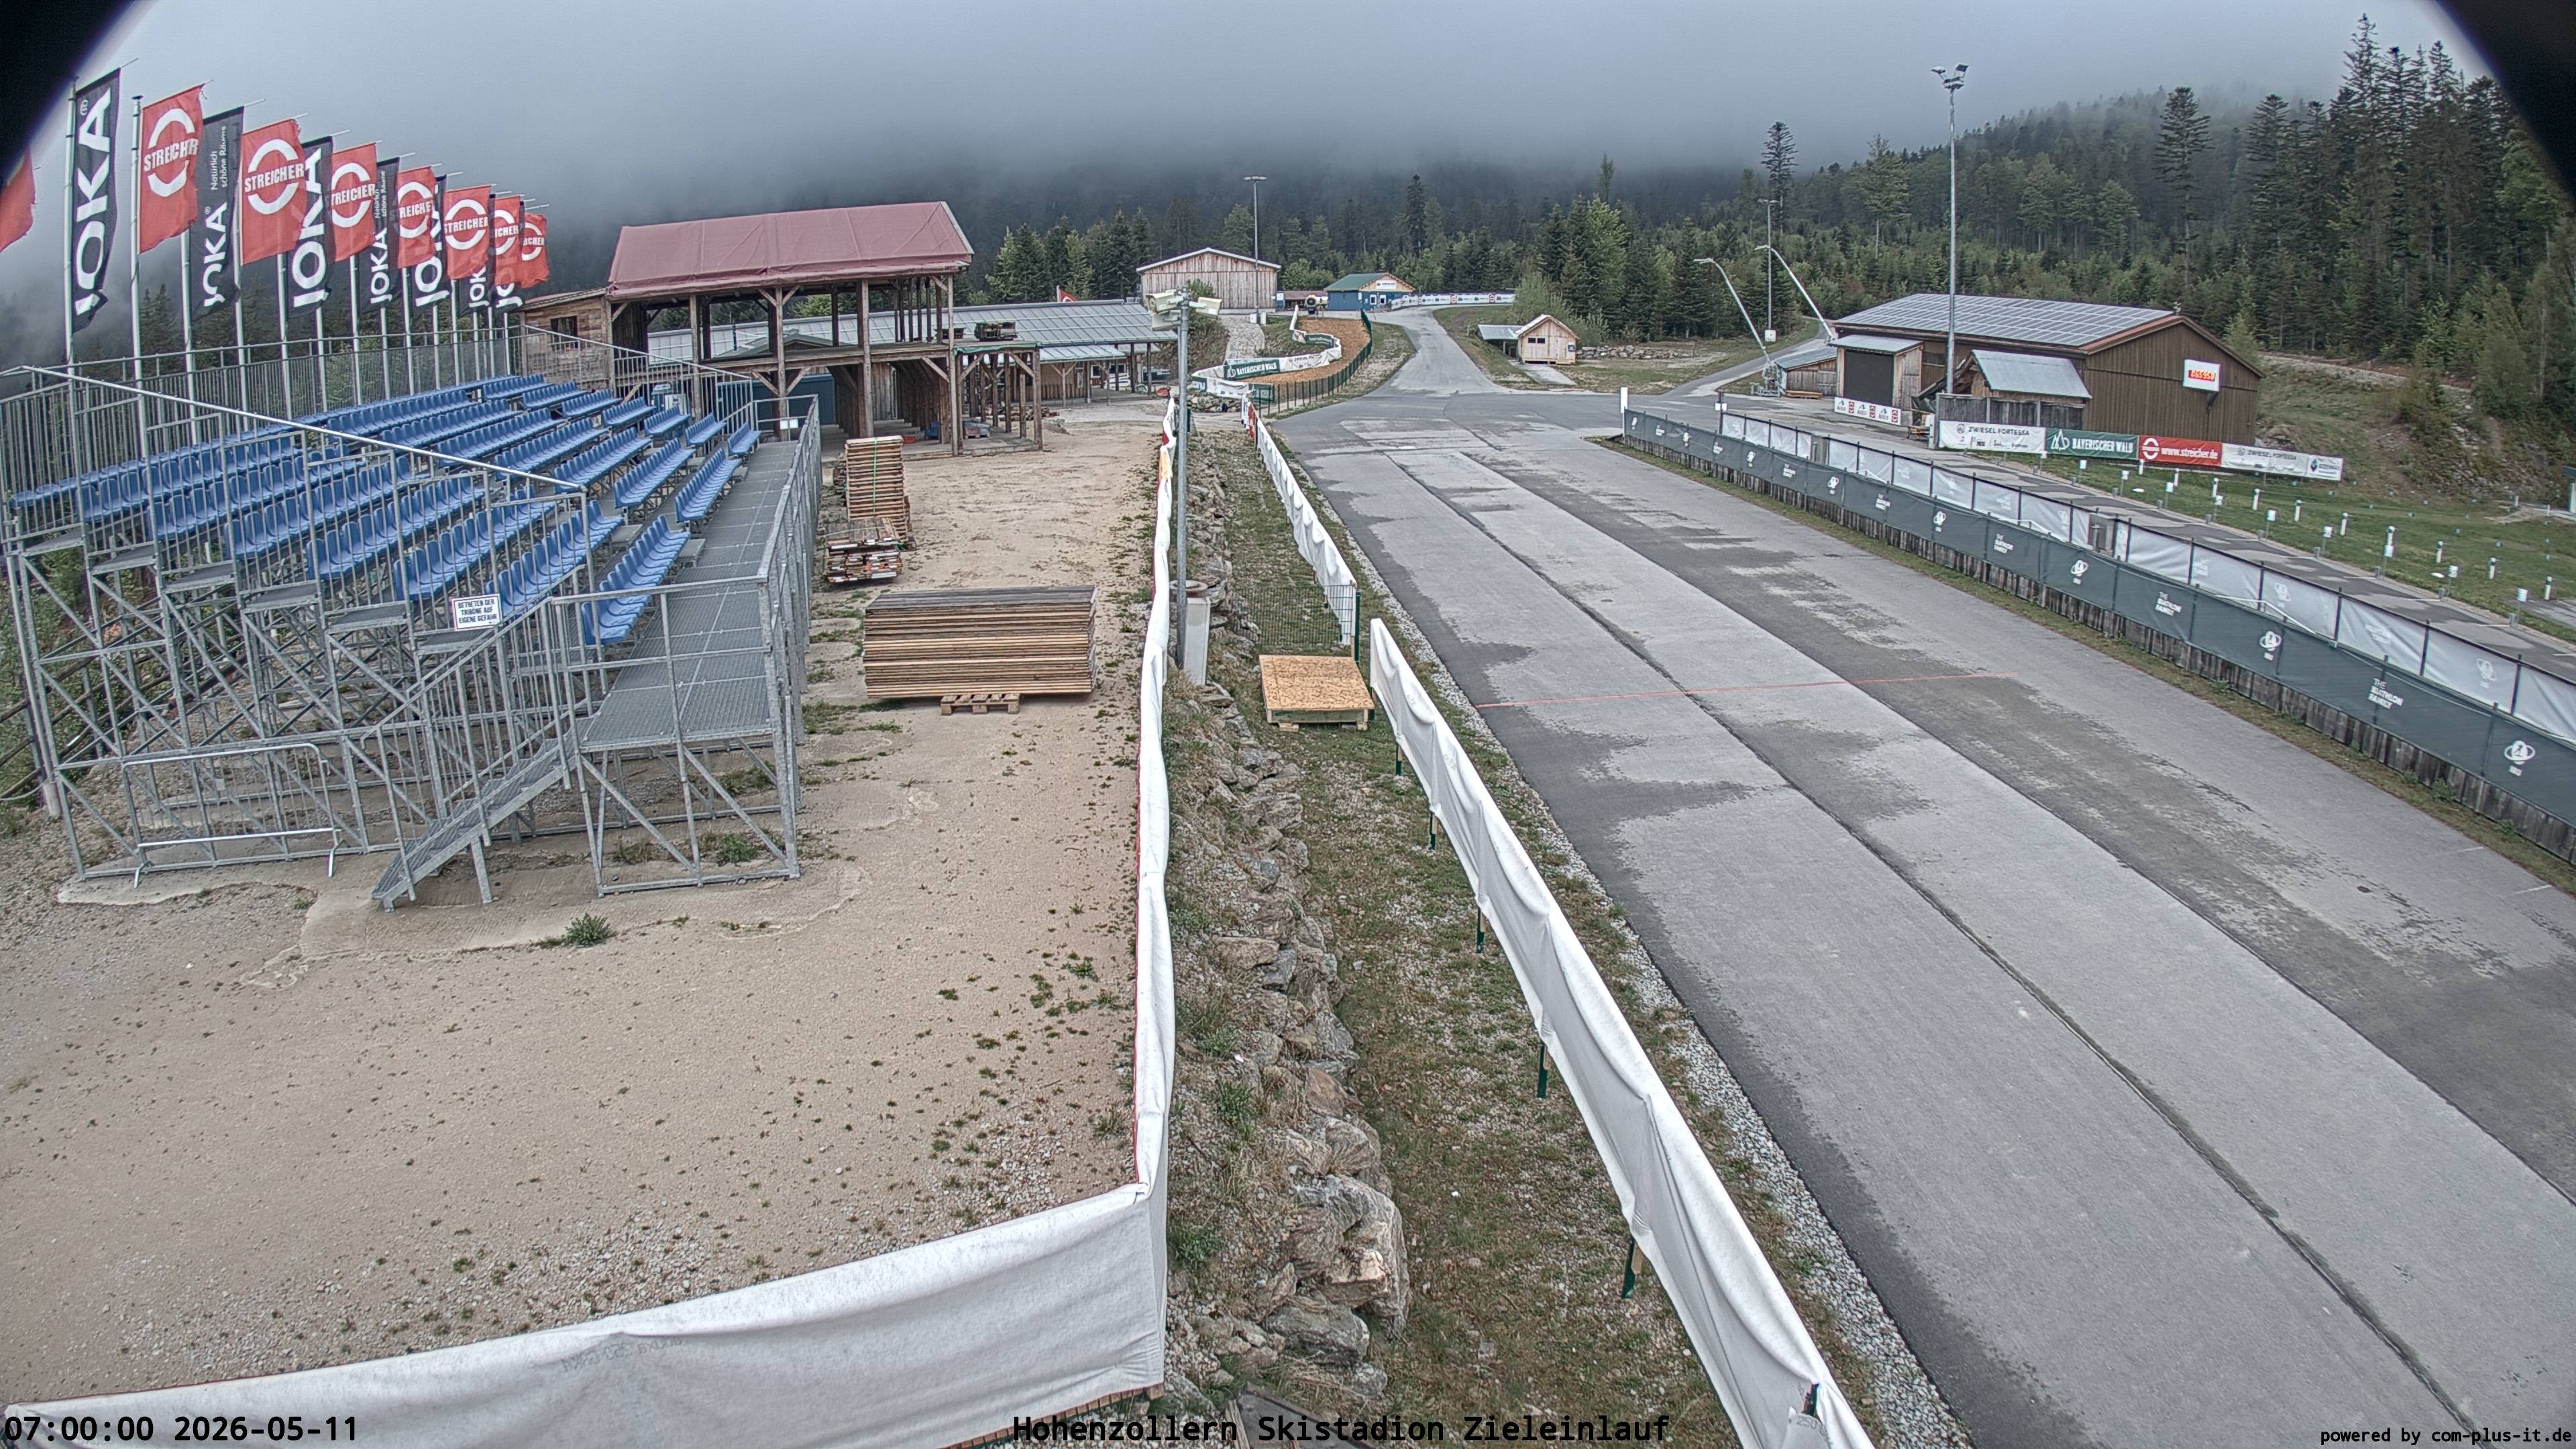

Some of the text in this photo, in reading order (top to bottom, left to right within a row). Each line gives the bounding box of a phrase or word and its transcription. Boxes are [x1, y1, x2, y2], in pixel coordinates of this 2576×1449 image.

[144, 138, 199, 172] STREICHR
[244, 162, 305, 193] STREICHER
[370, 227, 392, 304] JOKA
[469, 266, 490, 308] JOK
[1968, 426, 2030, 436] ZWIESEL FORTESSA
[2072, 438, 2115, 452] BAYERISCHER
[2116, 441, 2133, 453] WALD
[2161, 447, 2218, 460] www.streicher.de
